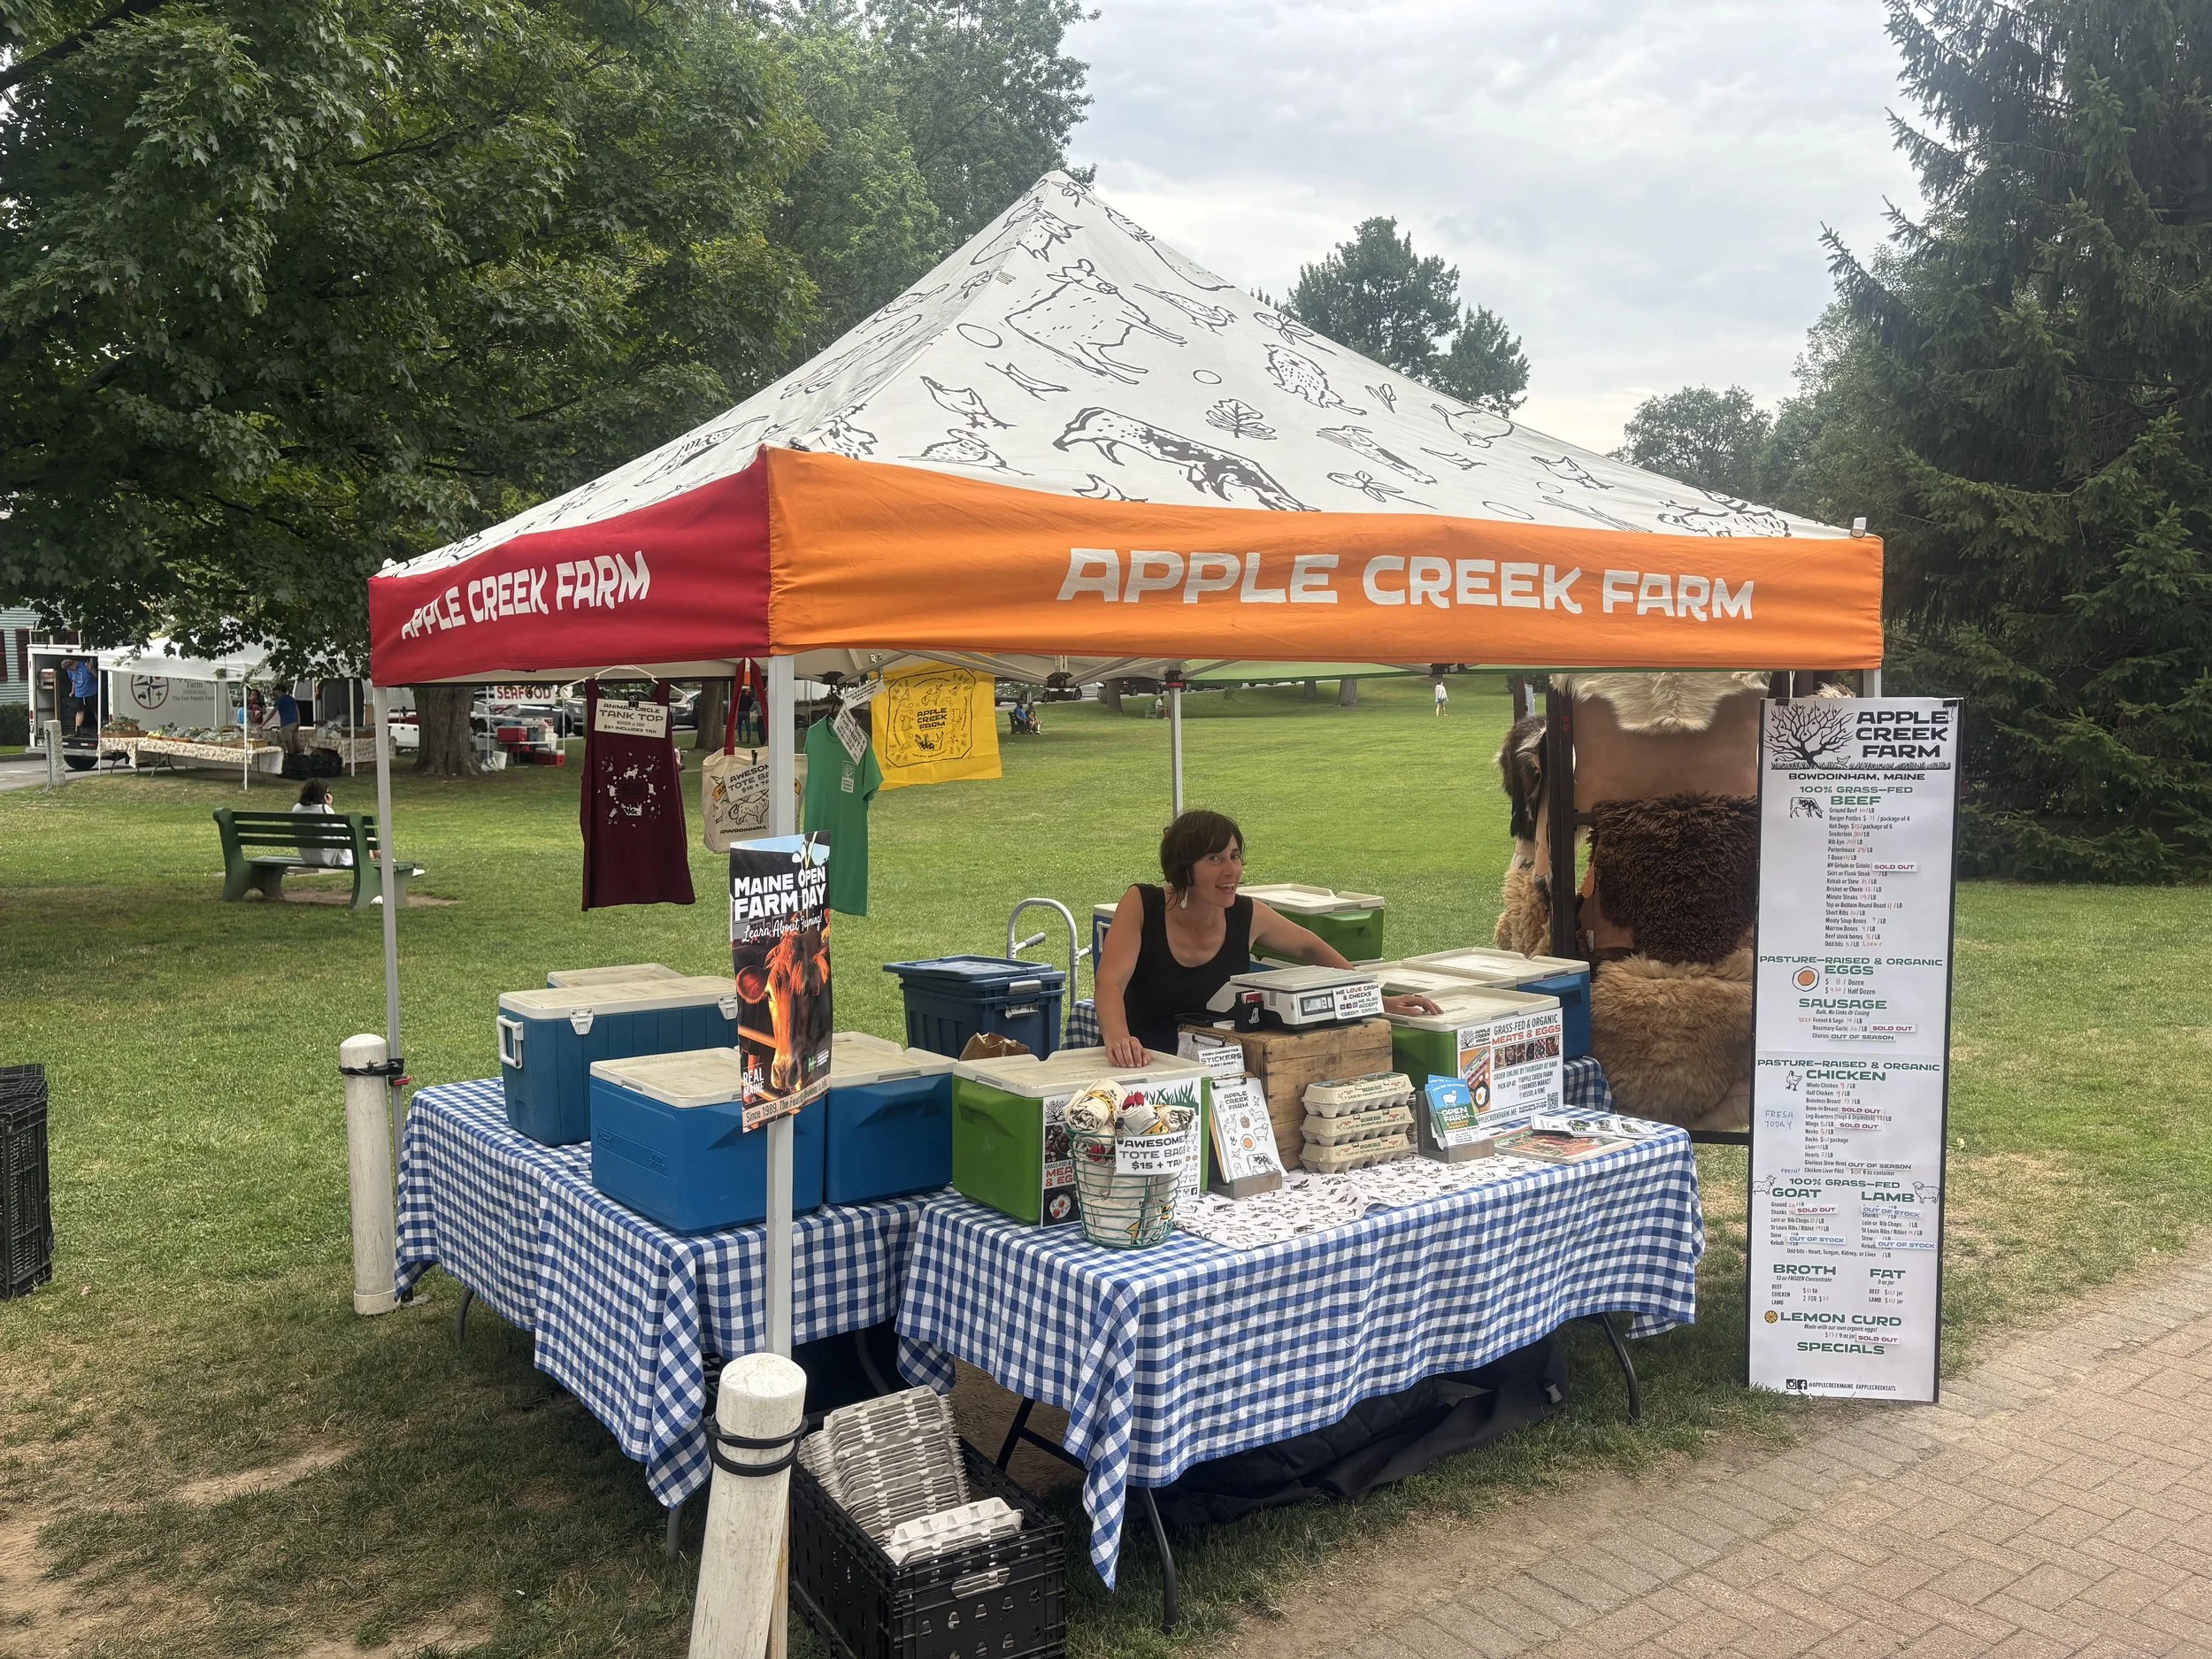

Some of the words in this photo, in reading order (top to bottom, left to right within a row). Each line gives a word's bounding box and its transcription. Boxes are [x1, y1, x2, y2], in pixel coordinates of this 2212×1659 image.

[1056, 548, 1339, 603] APPLE
[1363, 555, 1583, 614] CREEK
[1602, 569, 1754, 621] FARM
[402, 586, 466, 640] APPLE
[468, 566, 549, 622] CREEK
[556, 550, 650, 611] FARM
[497, 686, 551, 699] SEAFOOD
[599, 710, 634, 719] TANK
[638, 713, 664, 722] TOP
[917, 708, 948, 717] APPLE
[1856, 711, 1949, 725] APPLE
[917, 714, 948, 724] CREEK
[1855, 727, 1948, 741] CREEK
[1862, 745, 1940, 758] FARM
[730, 764, 769, 783] AWESO
[727, 777, 756, 791] TOTE
[1831, 795, 1882, 805] BEEF
[734, 872, 794, 897] MAINE
[798, 866, 826, 887] OPEN
[734, 890, 798, 921] FARM
[801, 883, 826, 909] DAY
[741, 925, 772, 942] Learn
[772, 918, 800, 938] About
[1760, 956, 1870, 964] PASTURE-RAISED
[1824, 965, 1874, 975] EGGS
[1348, 991, 1371, 1000] CHECKS
[1799, 999, 1887, 1010] SAUSAGE
[1494, 1020, 1525, 1035] GRASS-FED
[1526, 1019, 1531, 1028] &
[1532, 1014, 1558, 1027] ORGANIC
[1492, 1032, 1524, 1045] MEATS
[1535, 1025, 1561, 1035] EGGS
[1201, 1053, 1242, 1064] STICKERS
[1757, 1059, 1867, 1068] PASTURE-RAISED
[743, 1067, 764, 1085] REAL
[1506, 1069, 1519, 1078] ONLINE
[1525, 1064, 1543, 1072] THURSDAY
[1806, 1070, 1886, 1080] CHICKEN
[743, 1081, 764, 1096] MAINE
[1497, 1081, 1511, 1090] PICK-UP
[1521, 1081, 1538, 1090] FARMERS
[1538, 1078, 1551, 1087] MARKET
[1225, 1090, 1248, 1099] APPLE
[1225, 1095, 1248, 1104] CREEK
[1522, 1089, 1534, 1099] VESSEL
[746, 1110, 761, 1123] Since
[762, 1104, 779, 1118] 1989.
[780, 1099, 789, 1111] The
[1228, 1102, 1248, 1110] FARM
[1441, 1106, 1468, 1117] OPEN
[1444, 1112, 1469, 1123] FARM
[1478, 1108, 1517, 1124] PPLECREEKFARM.ME
[1765, 1110, 1793, 1119] FRESH
[1764, 1120, 1793, 1130] TODAY
[1125, 1135, 1185, 1148] AWESOME
[1119, 1150, 1160, 1159] TOTE
[1164, 1147, 1186, 1156] BAGS
[1132, 1162, 1153, 1171] $15
[1166, 1158, 1182, 1167] TAX
[1046, 1167, 1073, 1177] MEA
[1056, 1174, 1073, 1184] EG
[1825, 1179, 1901, 1188] GRASS-FED
[1771, 1188, 1822, 1198] GOAT
[1861, 1191, 1915, 1202] LAMB
[1773, 1264, 1836, 1275] BROTH
[1870, 1268, 1906, 1279] FAT
[1780, 1312, 1845, 1324] LEMON
[1851, 1315, 1902, 1326] CURD
[1797, 1341, 1885, 1355] SPECIALS
